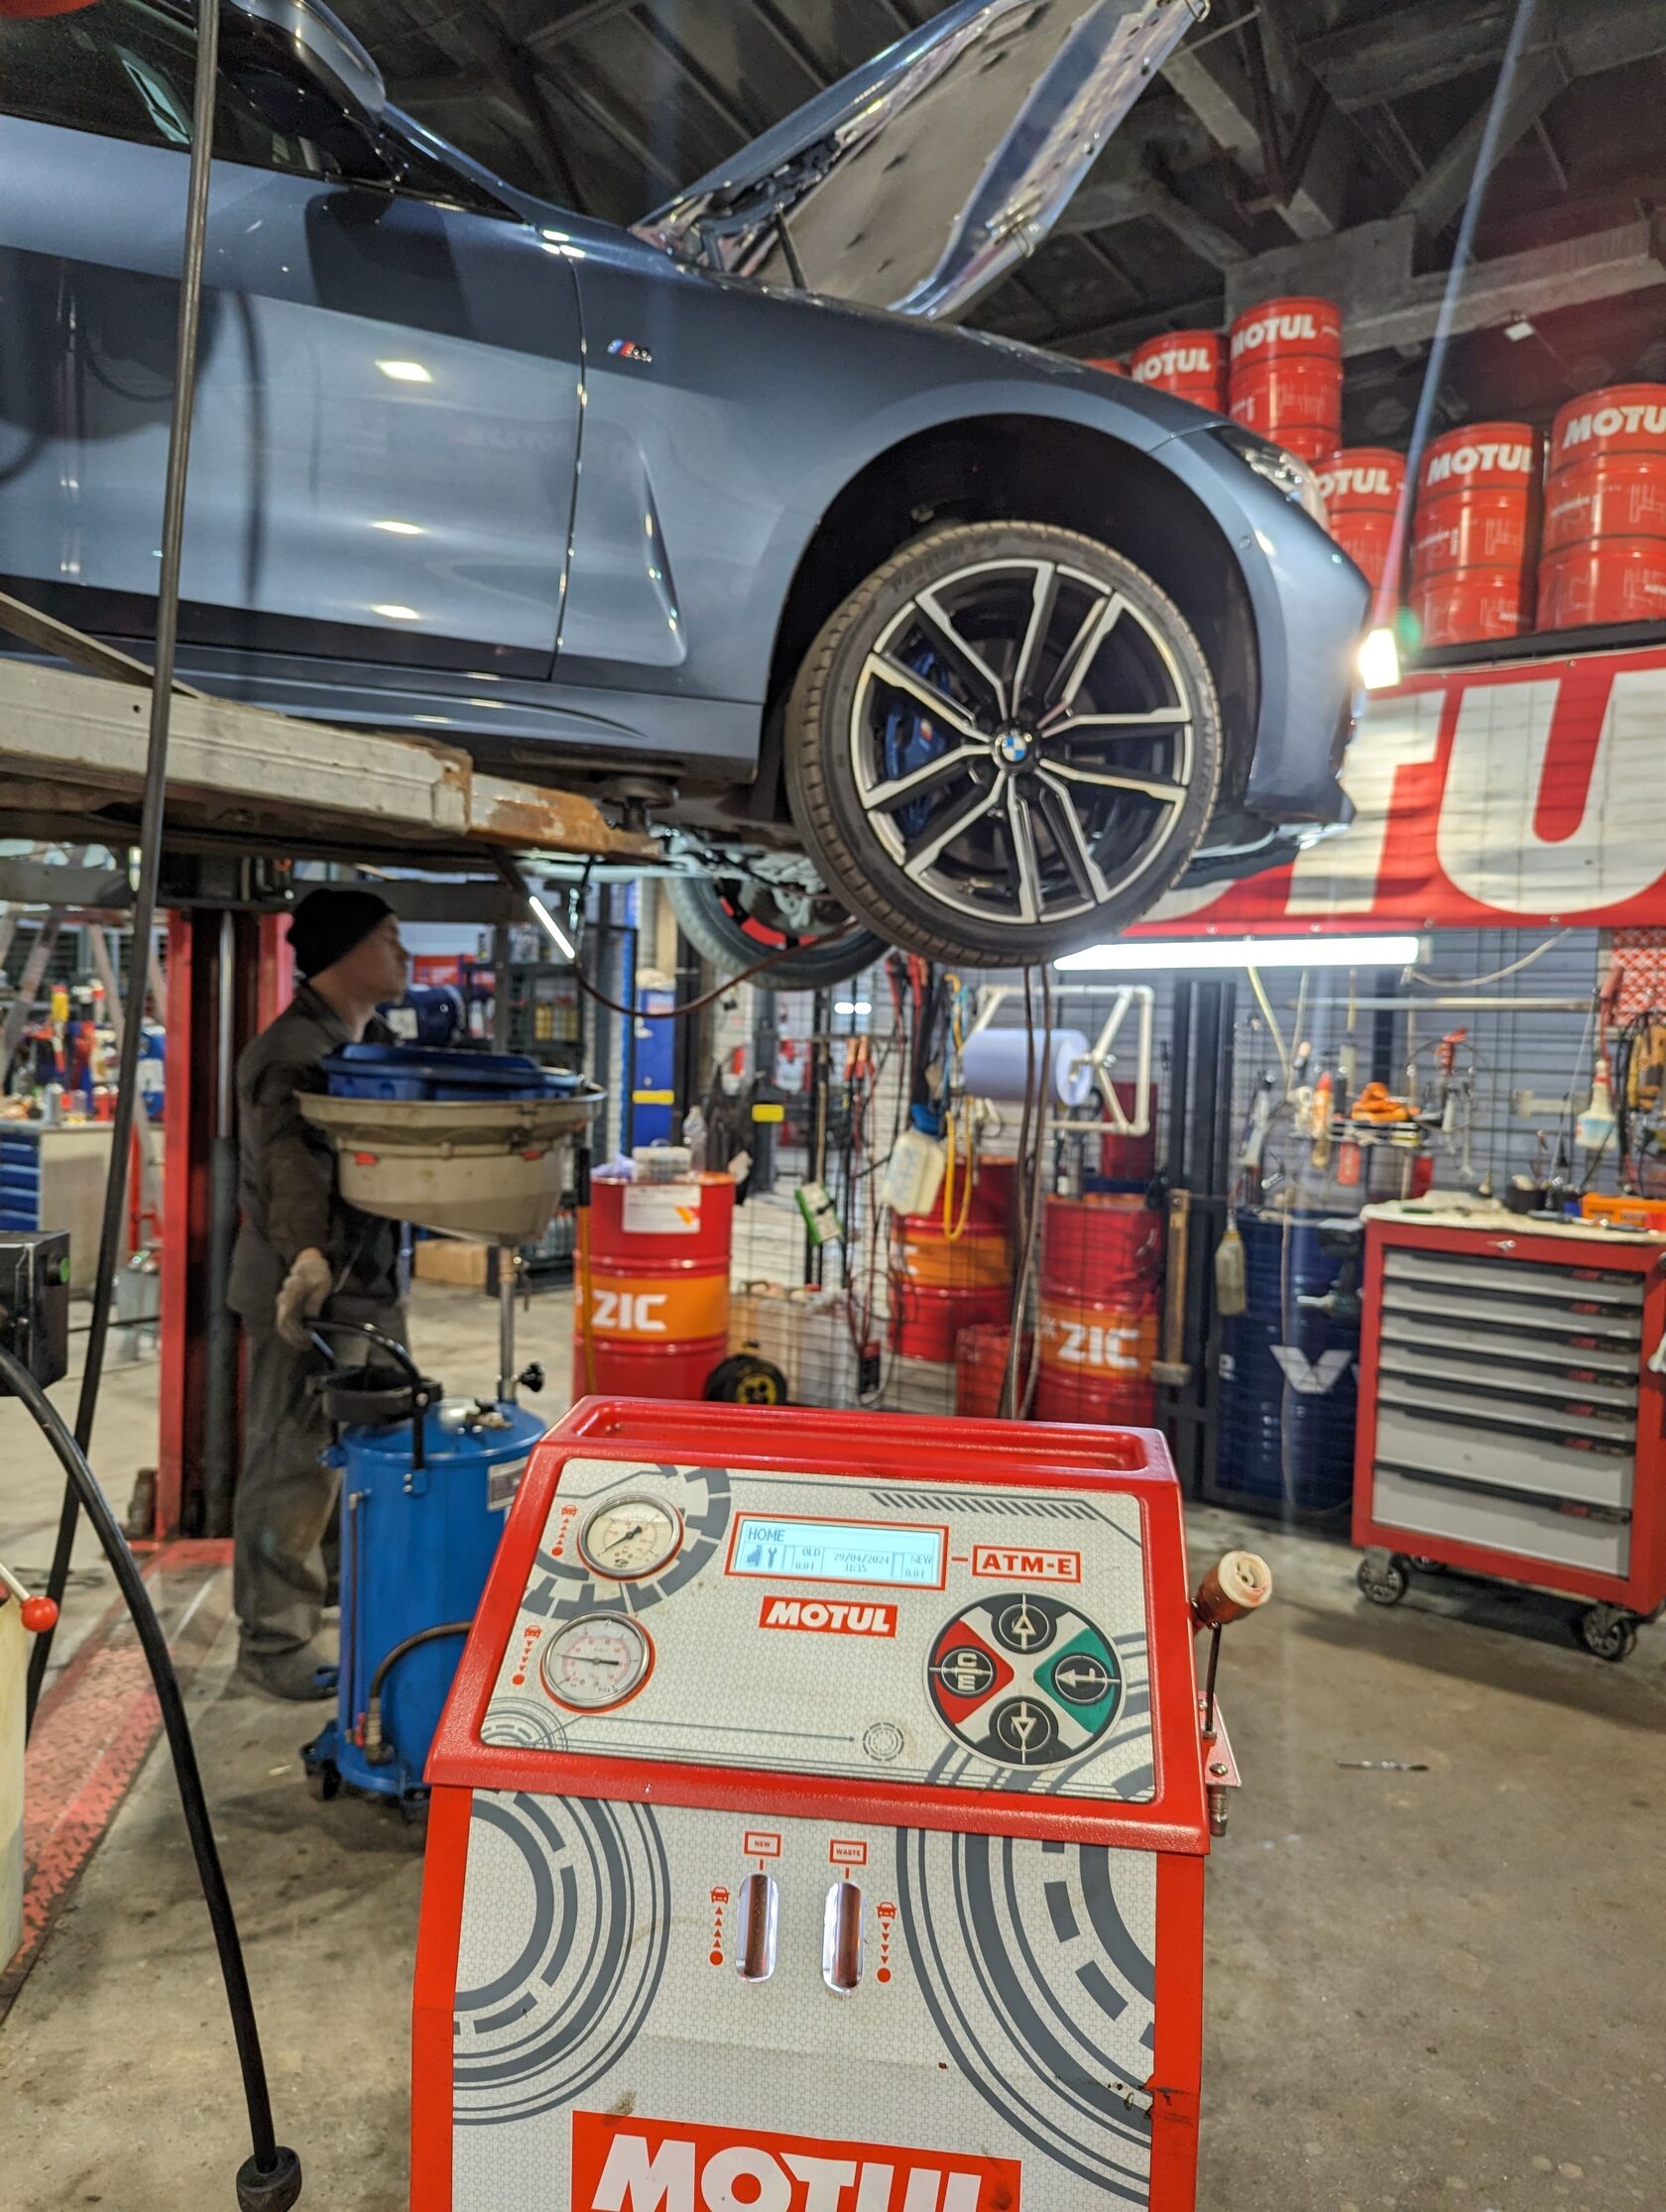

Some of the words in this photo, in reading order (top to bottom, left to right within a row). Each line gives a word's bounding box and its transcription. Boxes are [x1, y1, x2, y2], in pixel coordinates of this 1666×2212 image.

[1426, 443, 1535, 486] MOTUL
[1316, 467, 1391, 498] OTUL
[591, 1288, 667, 1334] ZIC
[1056, 1320, 1140, 1369] ZIC
[748, 1528, 786, 1543] HOME
[801, 1547, 821, 1557] OLD
[833, 1552, 890, 1566] 29/04/2024
[910, 1554, 933, 1565] NEW
[982, 1553, 1073, 1575] ATM-E
[766, 1600, 891, 1633] MOTUL
[755, 1840, 771, 1849] NEW
[836, 1848, 862, 1857] WASTE
